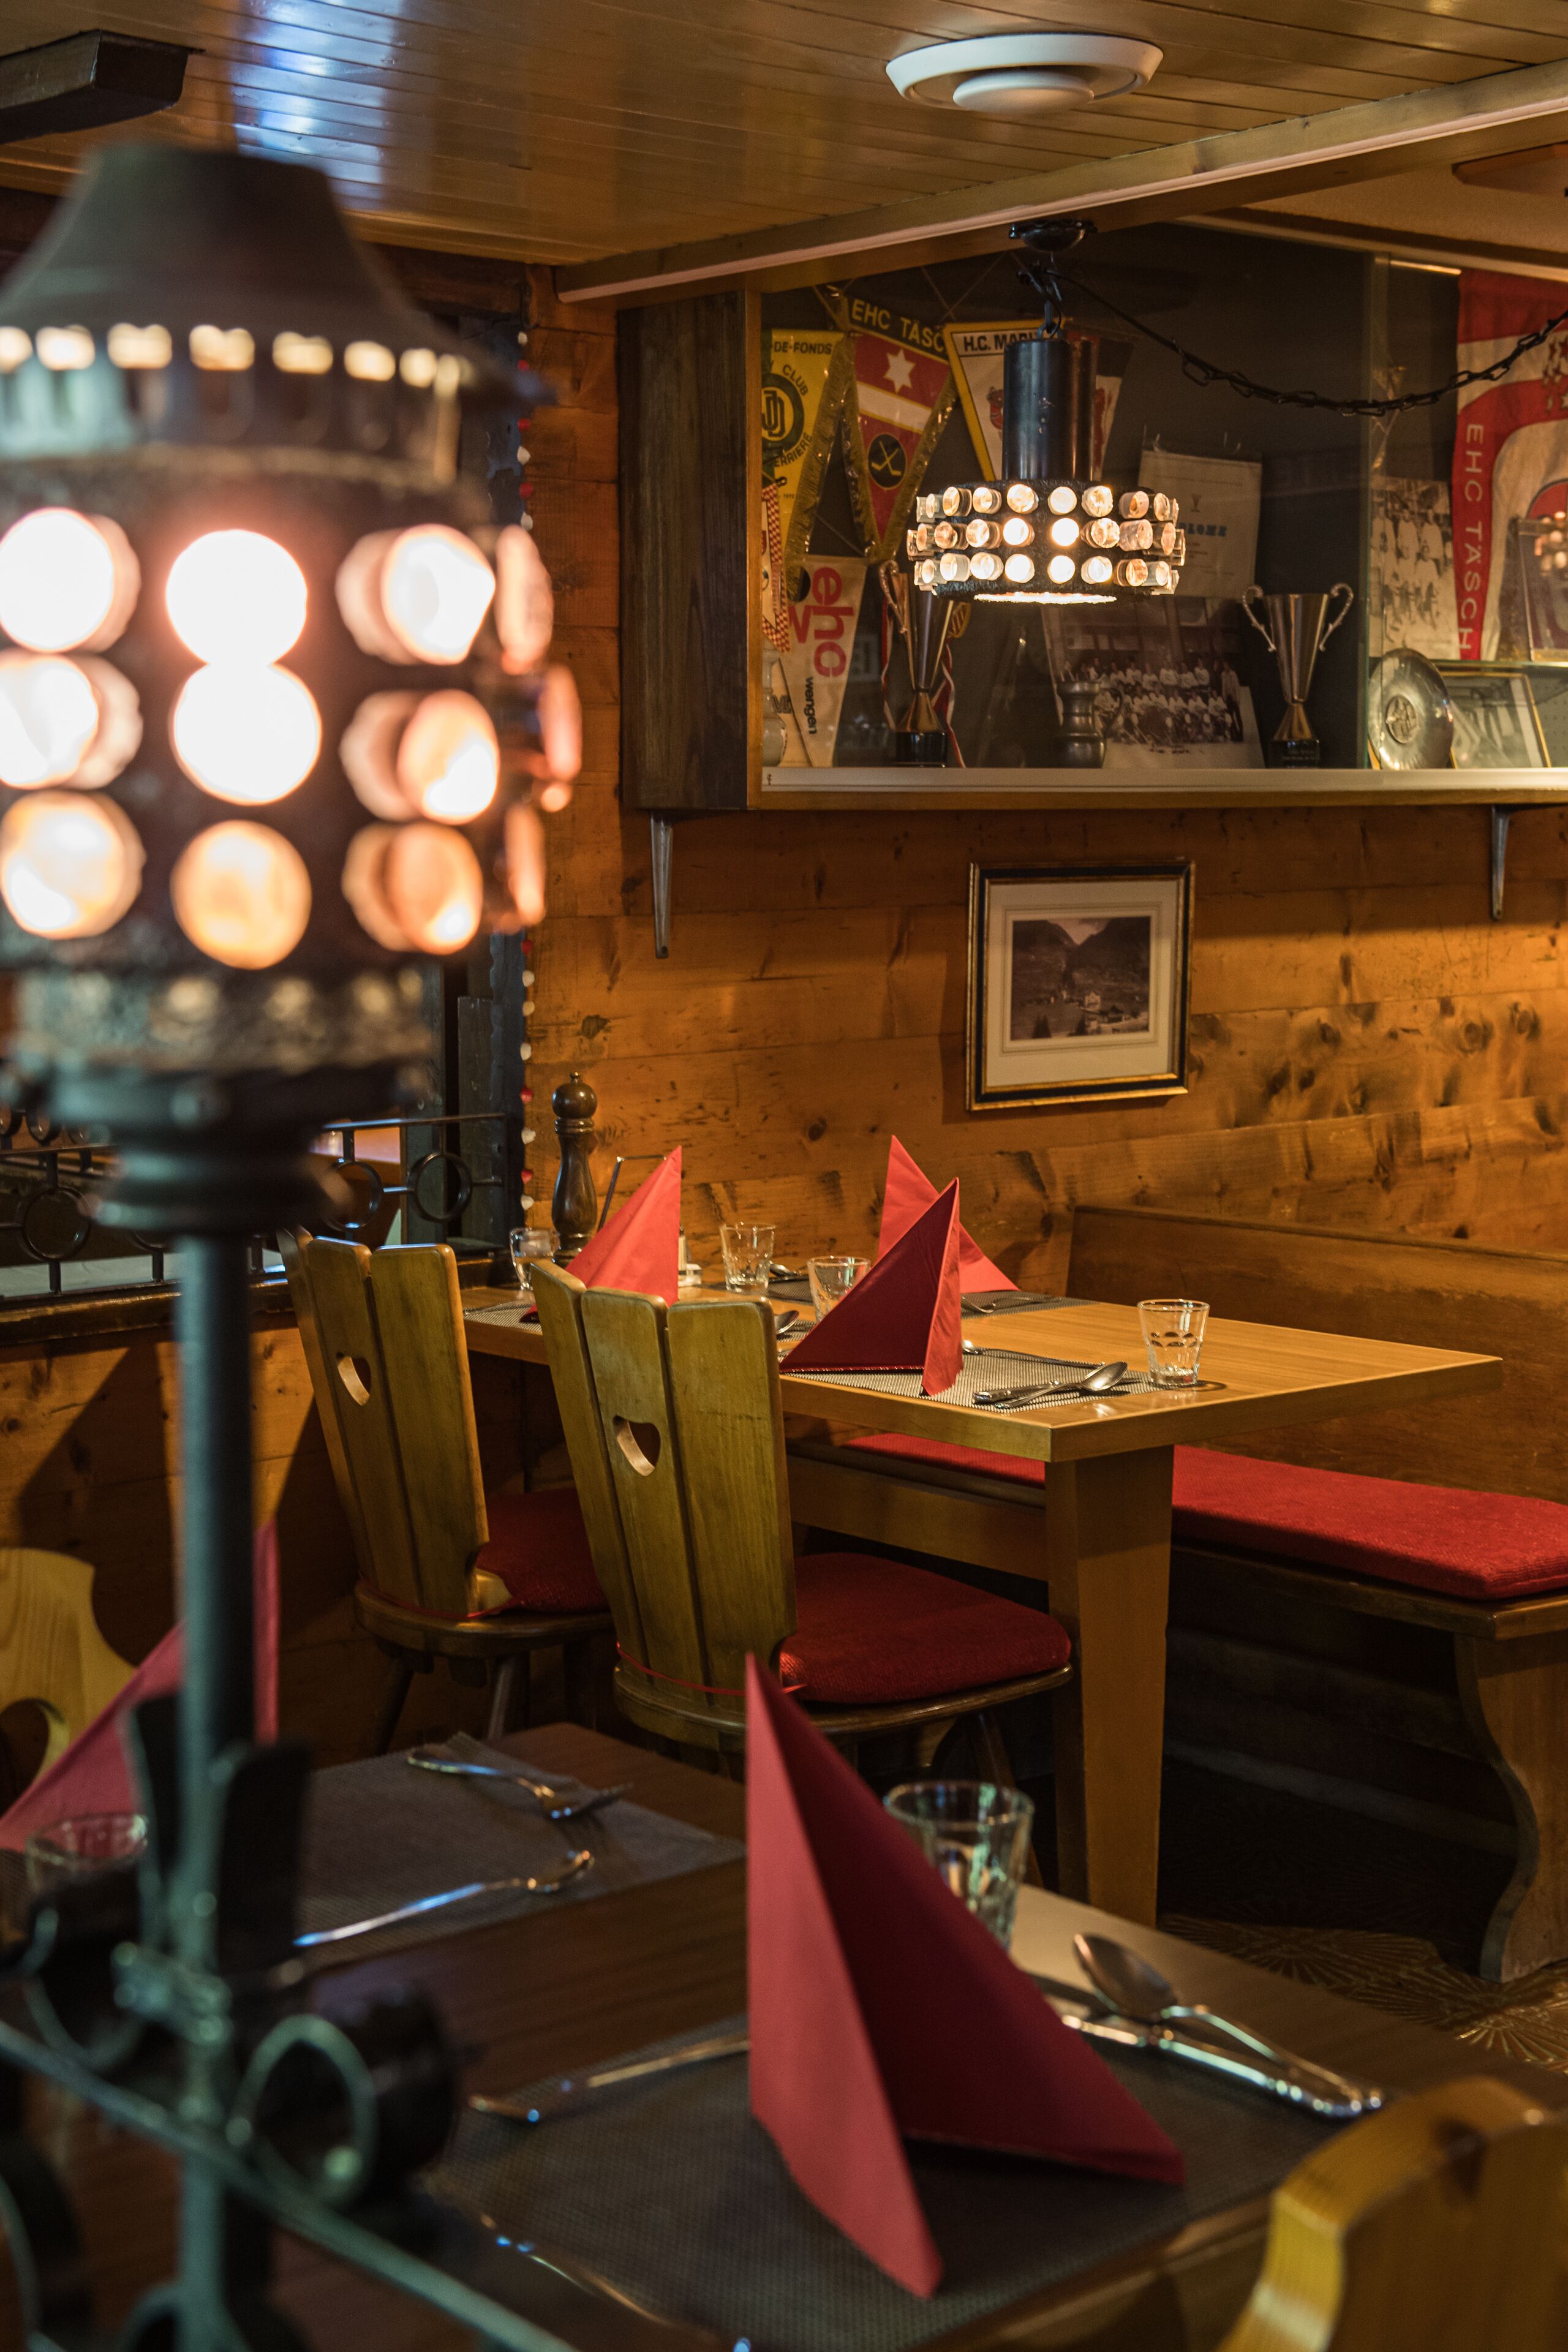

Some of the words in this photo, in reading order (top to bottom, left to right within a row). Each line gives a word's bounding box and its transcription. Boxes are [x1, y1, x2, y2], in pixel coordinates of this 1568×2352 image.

[852, 298, 891, 330] EHC
[963, 336, 990, 352] H.C.
[782, 364, 809, 396] CLUB
[1464, 424, 1483, 502] EHC
[1458, 521, 1482, 650] TÄSCH
[812, 567, 854, 678] ehc
[804, 677, 817, 735] wengen
